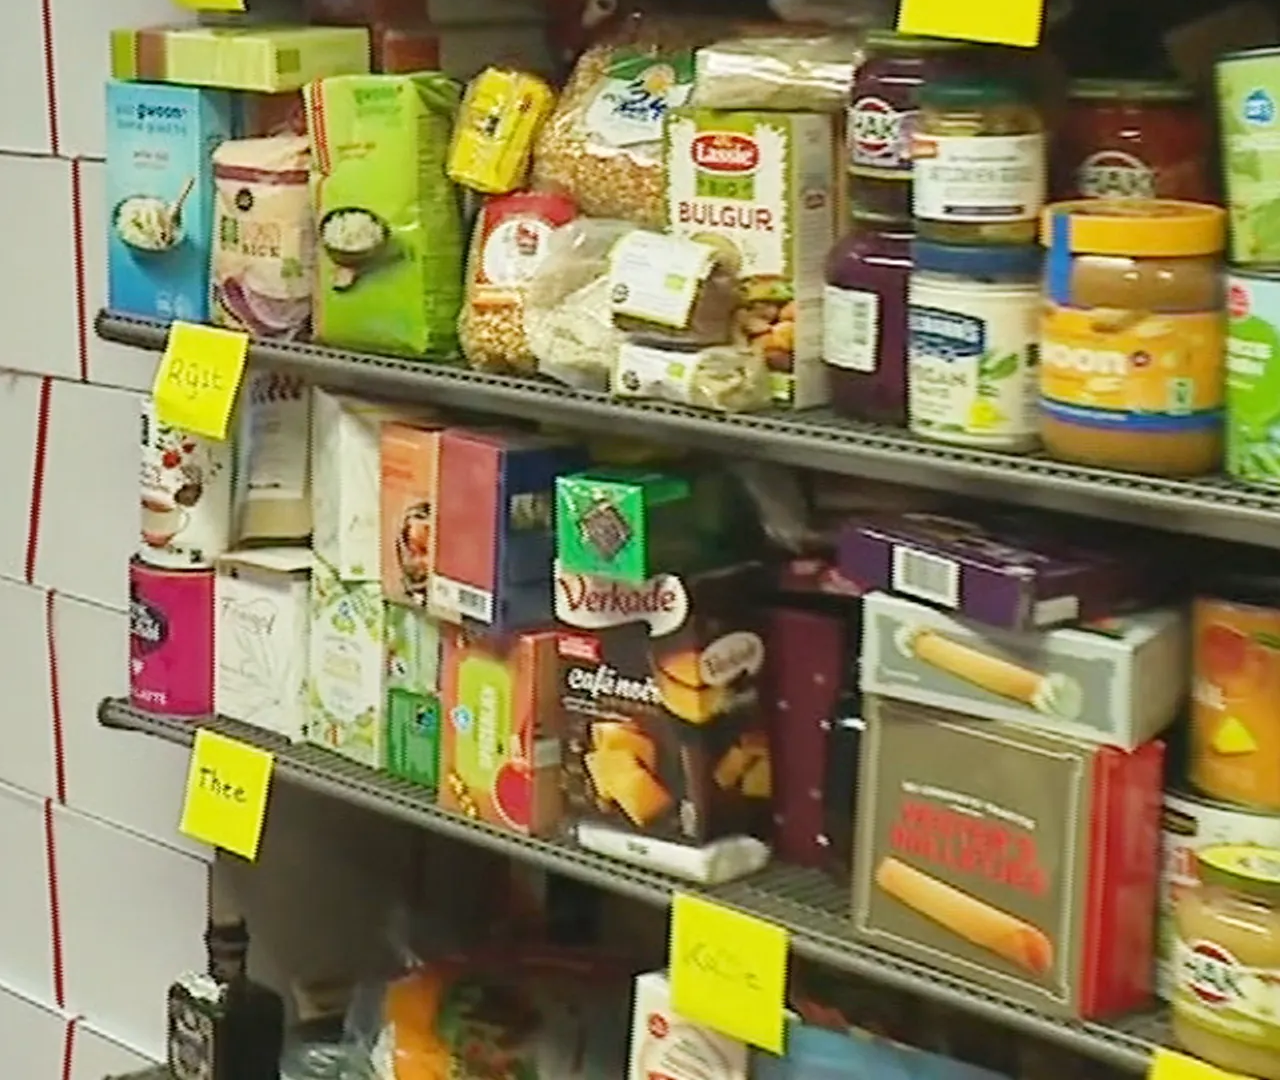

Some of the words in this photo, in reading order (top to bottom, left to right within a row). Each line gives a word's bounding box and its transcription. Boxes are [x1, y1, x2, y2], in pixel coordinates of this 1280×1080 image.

[677, 200, 774, 232] BULGUR
[558, 571, 676, 616] Verkade
[199, 766, 248, 803] Thee
